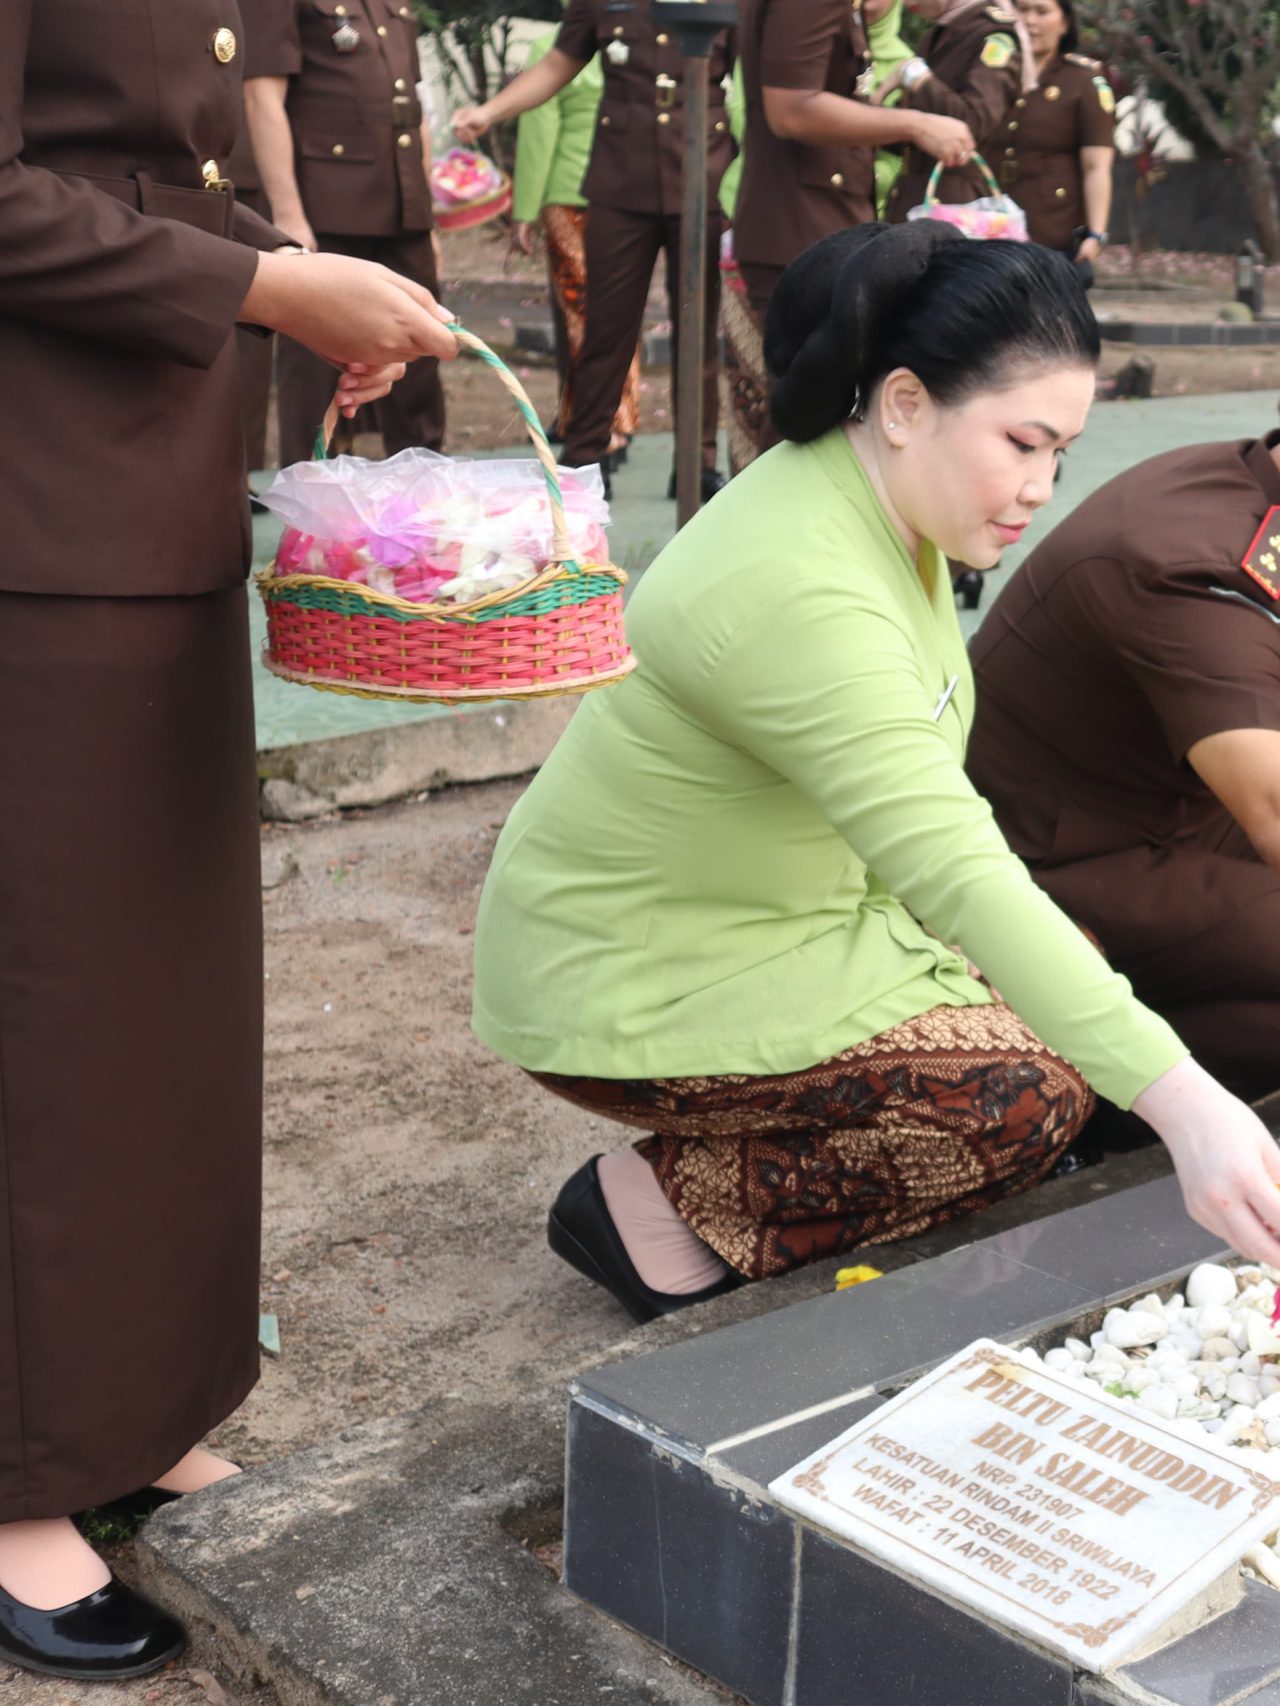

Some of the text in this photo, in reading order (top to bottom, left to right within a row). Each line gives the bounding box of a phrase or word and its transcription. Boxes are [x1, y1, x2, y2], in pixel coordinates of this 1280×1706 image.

[963, 1368, 1245, 1510] PELTU ZAINUDDIN
[970, 1421, 1150, 1517] BIN SALEH
[1015, 1484, 1086, 1520] 231907
[852, 1457, 917, 1495] LAHIR
[922, 1494, 954, 1515] 22
[949, 1507, 1069, 1574] DESEMBER
[1067, 1568, 1121, 1601] 1922
[852, 1484, 926, 1526] WAFAT
[932, 1527, 960, 1546] 11
[953, 1540, 1018, 1581] APRIL
[1016, 1572, 1073, 1606] 2018
[864, 1433, 966, 1489] KESATUAN
[959, 1482, 1040, 1527] RINDAM
[1051, 1527, 1157, 1589] SRIWIJAYA
